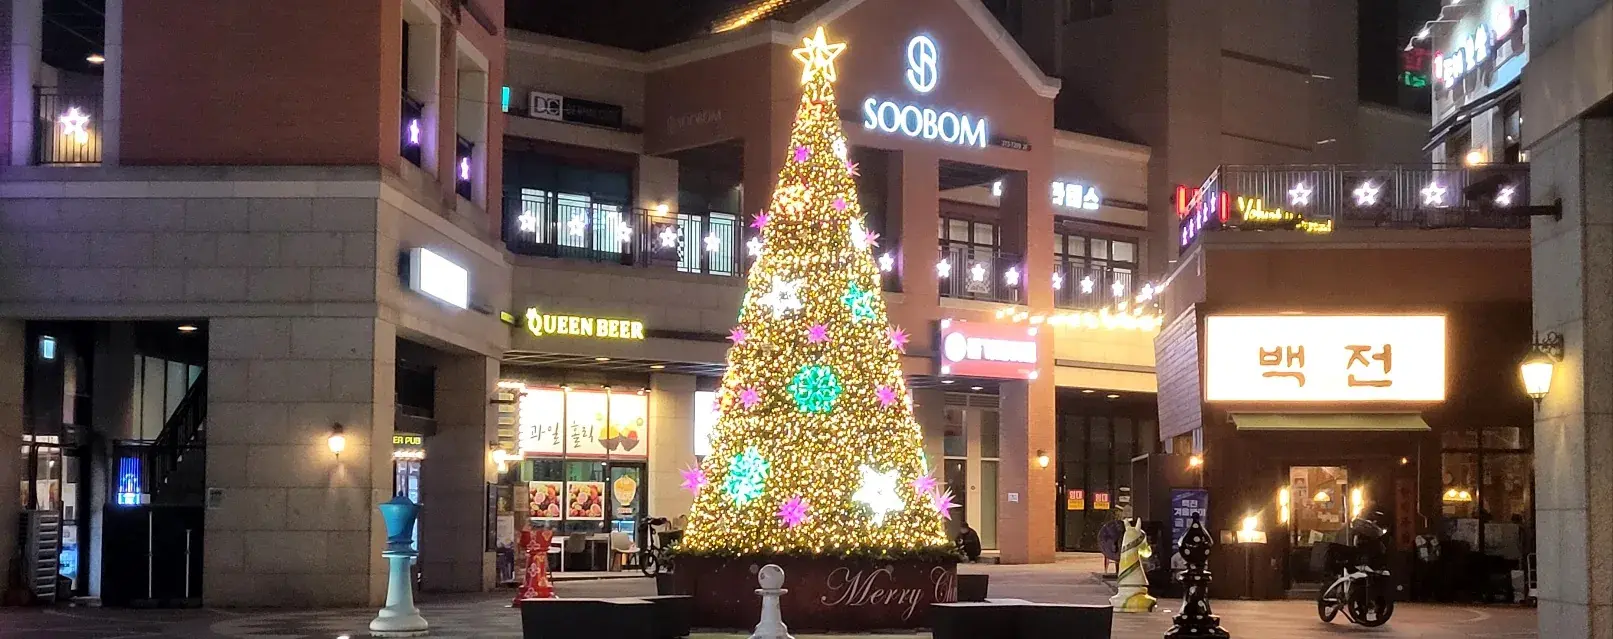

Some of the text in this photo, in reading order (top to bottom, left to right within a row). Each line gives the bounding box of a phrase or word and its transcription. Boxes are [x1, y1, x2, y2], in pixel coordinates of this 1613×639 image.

[864, 98, 986, 148] SOOBOM
[526, 309, 644, 340] QUEEN BEER
[405, 436, 421, 445] PUB
[821, 566, 922, 620] Merry
